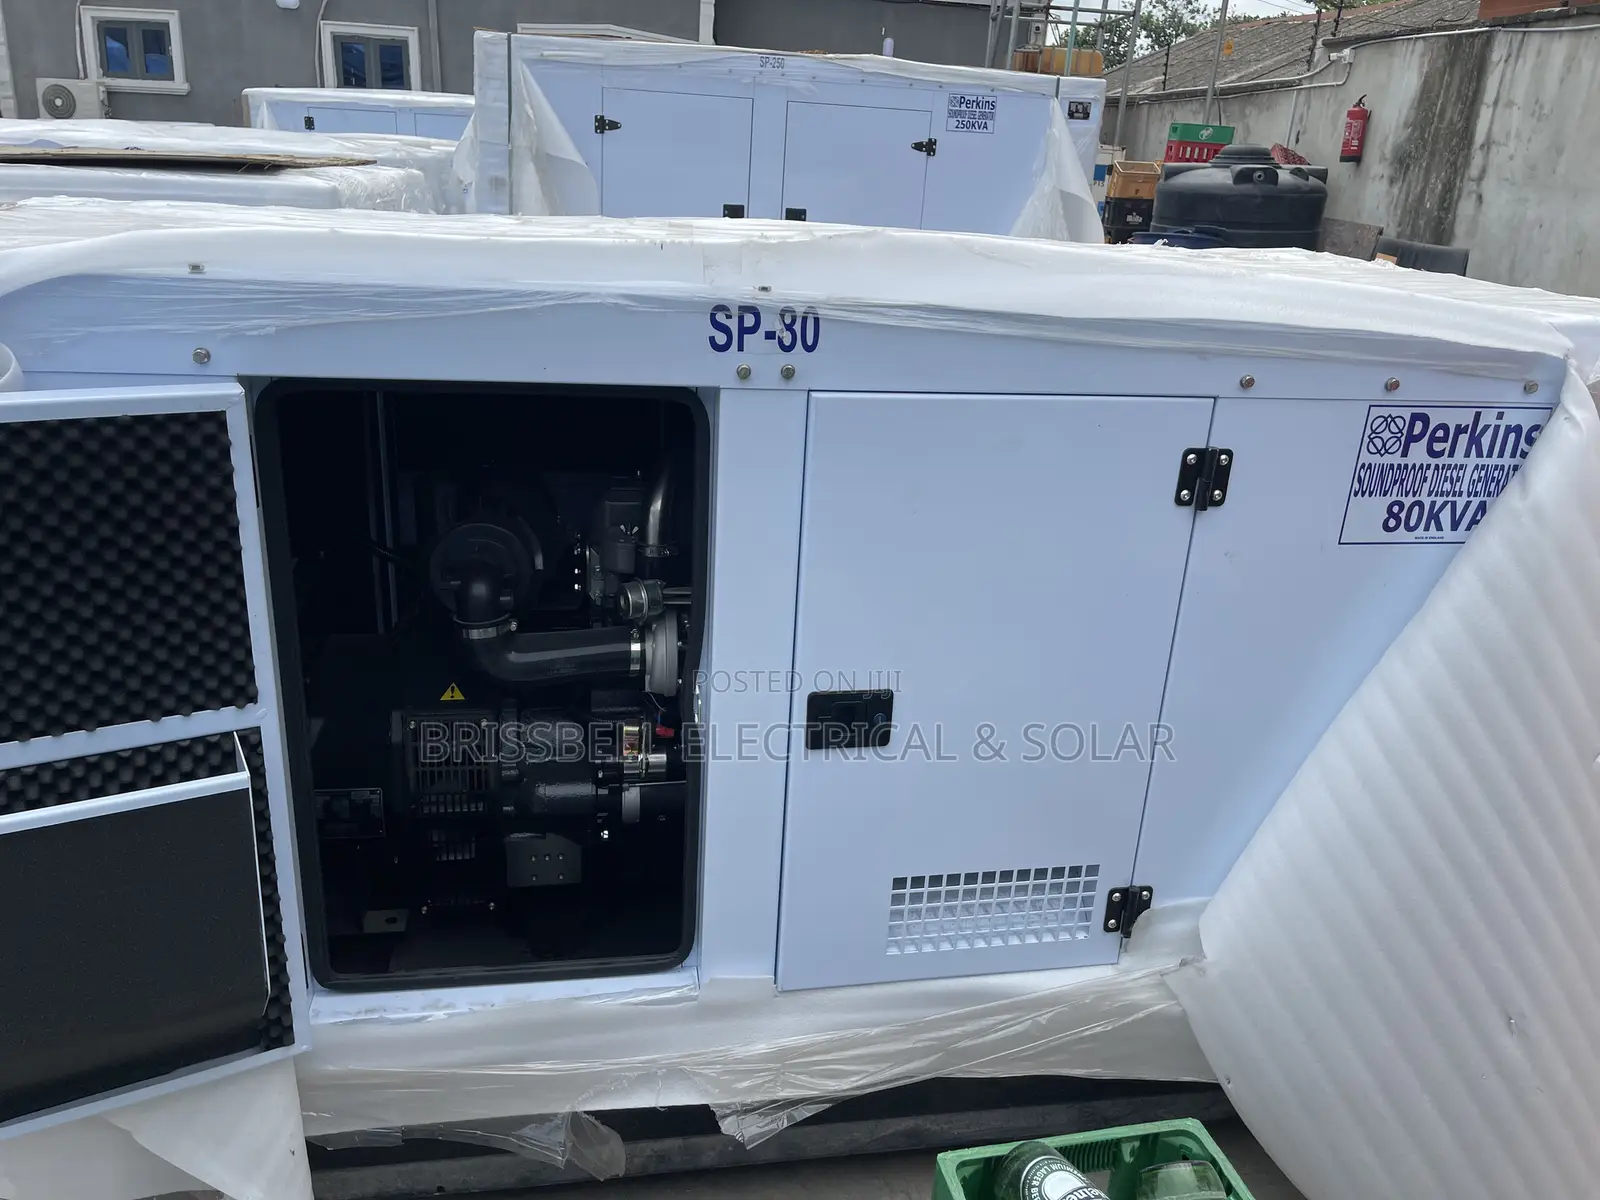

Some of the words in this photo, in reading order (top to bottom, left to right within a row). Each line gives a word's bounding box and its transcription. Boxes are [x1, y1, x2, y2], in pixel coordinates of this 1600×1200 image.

[759, 55, 785, 69] SP-250
[959, 95, 996, 111] Perkins
[955, 119, 988, 131] 250KVA
[708, 303, 820, 353] SP-80
[1399, 410, 1543, 460] Perkins
[1353, 462, 1431, 498] SOUNDPROOF
[1426, 463, 1469, 498] DIESEL
[1466, 463, 1523, 498] GENERAT
[1381, 500, 1488, 533] 80KVA
[1031, 1165, 1051, 1186] LAGER
